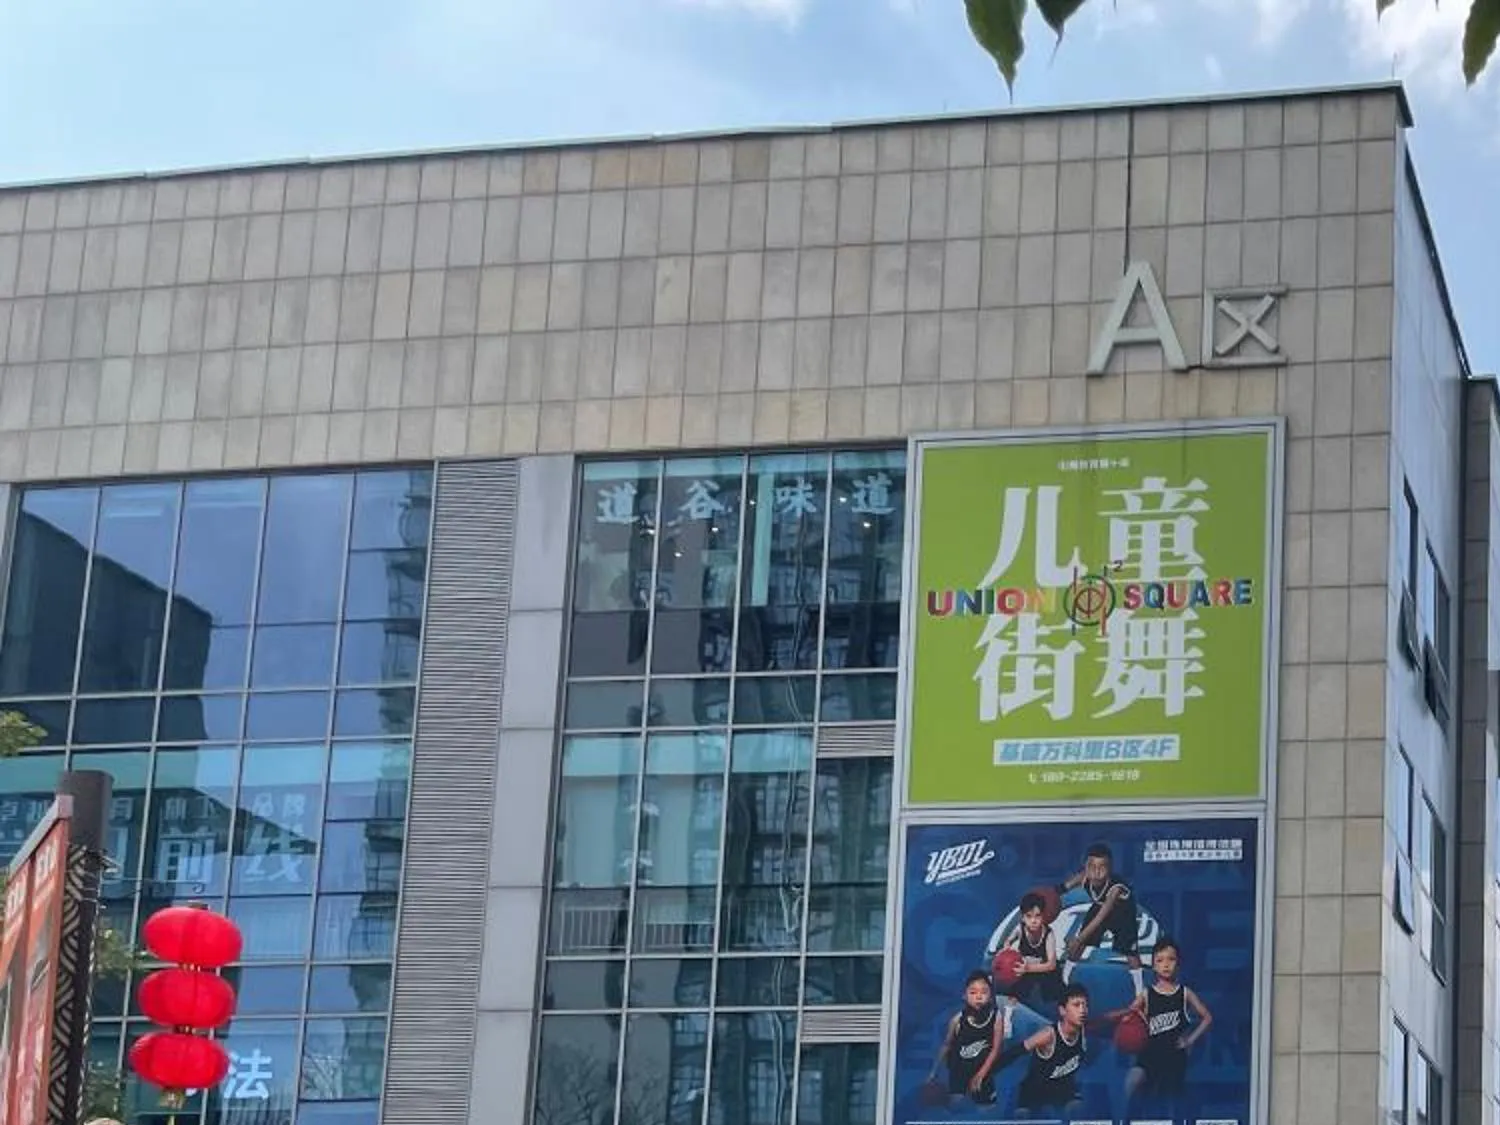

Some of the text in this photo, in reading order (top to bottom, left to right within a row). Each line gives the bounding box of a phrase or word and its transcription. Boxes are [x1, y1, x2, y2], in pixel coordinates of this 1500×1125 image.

[1087, 261, 1289, 378] A区
[975, 477, 1212, 592] 儿童
[927, 578, 1253, 616] UNION SQUARE
[972, 607, 1207, 722] 街舞
